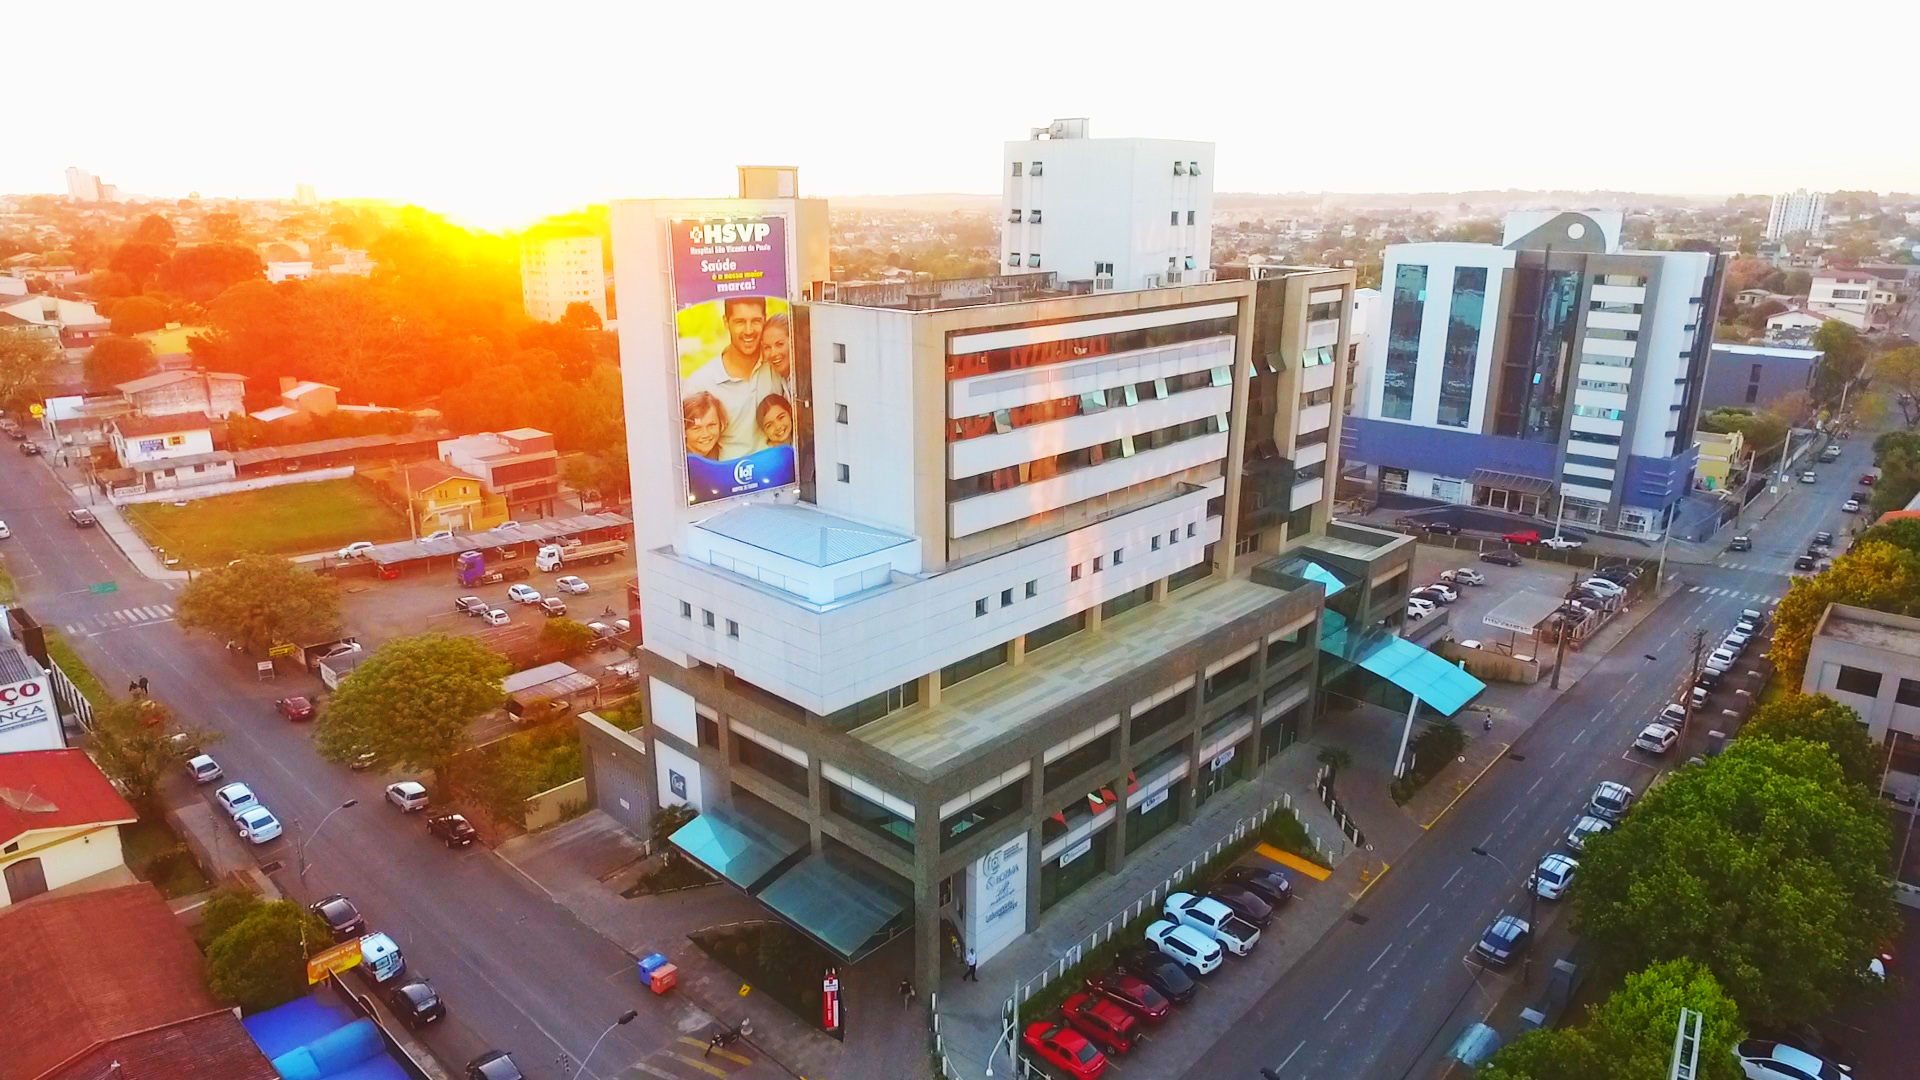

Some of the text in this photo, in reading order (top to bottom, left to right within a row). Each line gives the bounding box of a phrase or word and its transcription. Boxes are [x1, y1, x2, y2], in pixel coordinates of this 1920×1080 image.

[703, 223, 771, 244] HSVP
[689, 246, 714, 256] Hospital
[715, 245, 726, 253] São
[726, 244, 747, 253] Vicente
[755, 243, 772, 251] Paulo
[701, 258, 737, 272] Saúde
[744, 270, 764, 278] maior
[716, 278, 756, 292] marca!
